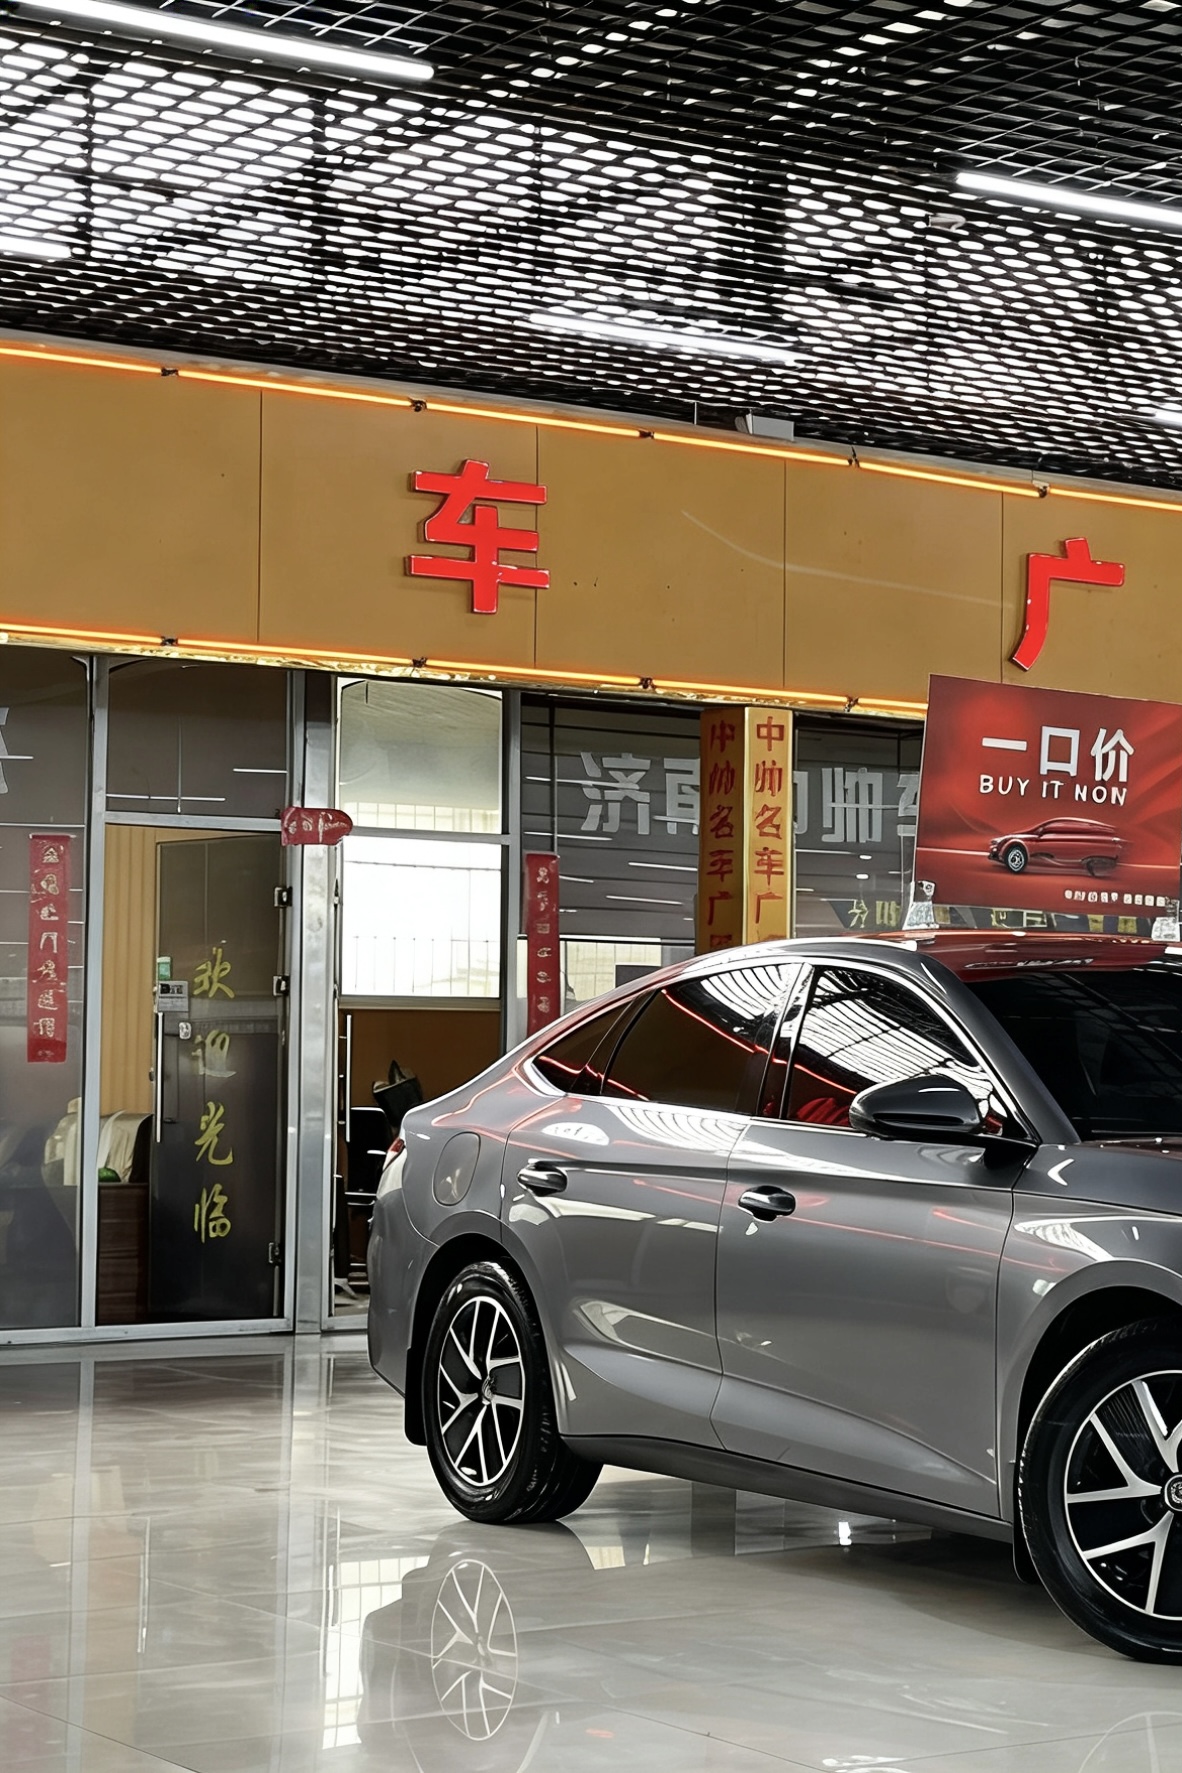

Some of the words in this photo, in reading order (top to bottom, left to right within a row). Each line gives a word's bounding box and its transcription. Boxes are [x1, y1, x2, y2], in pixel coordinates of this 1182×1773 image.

[981, 725, 1135, 783] 一口价
[979, 774, 1030, 797] BUY
[1041, 780, 1065, 799] IT
[754, 716, 785, 941] 中帅名车广
